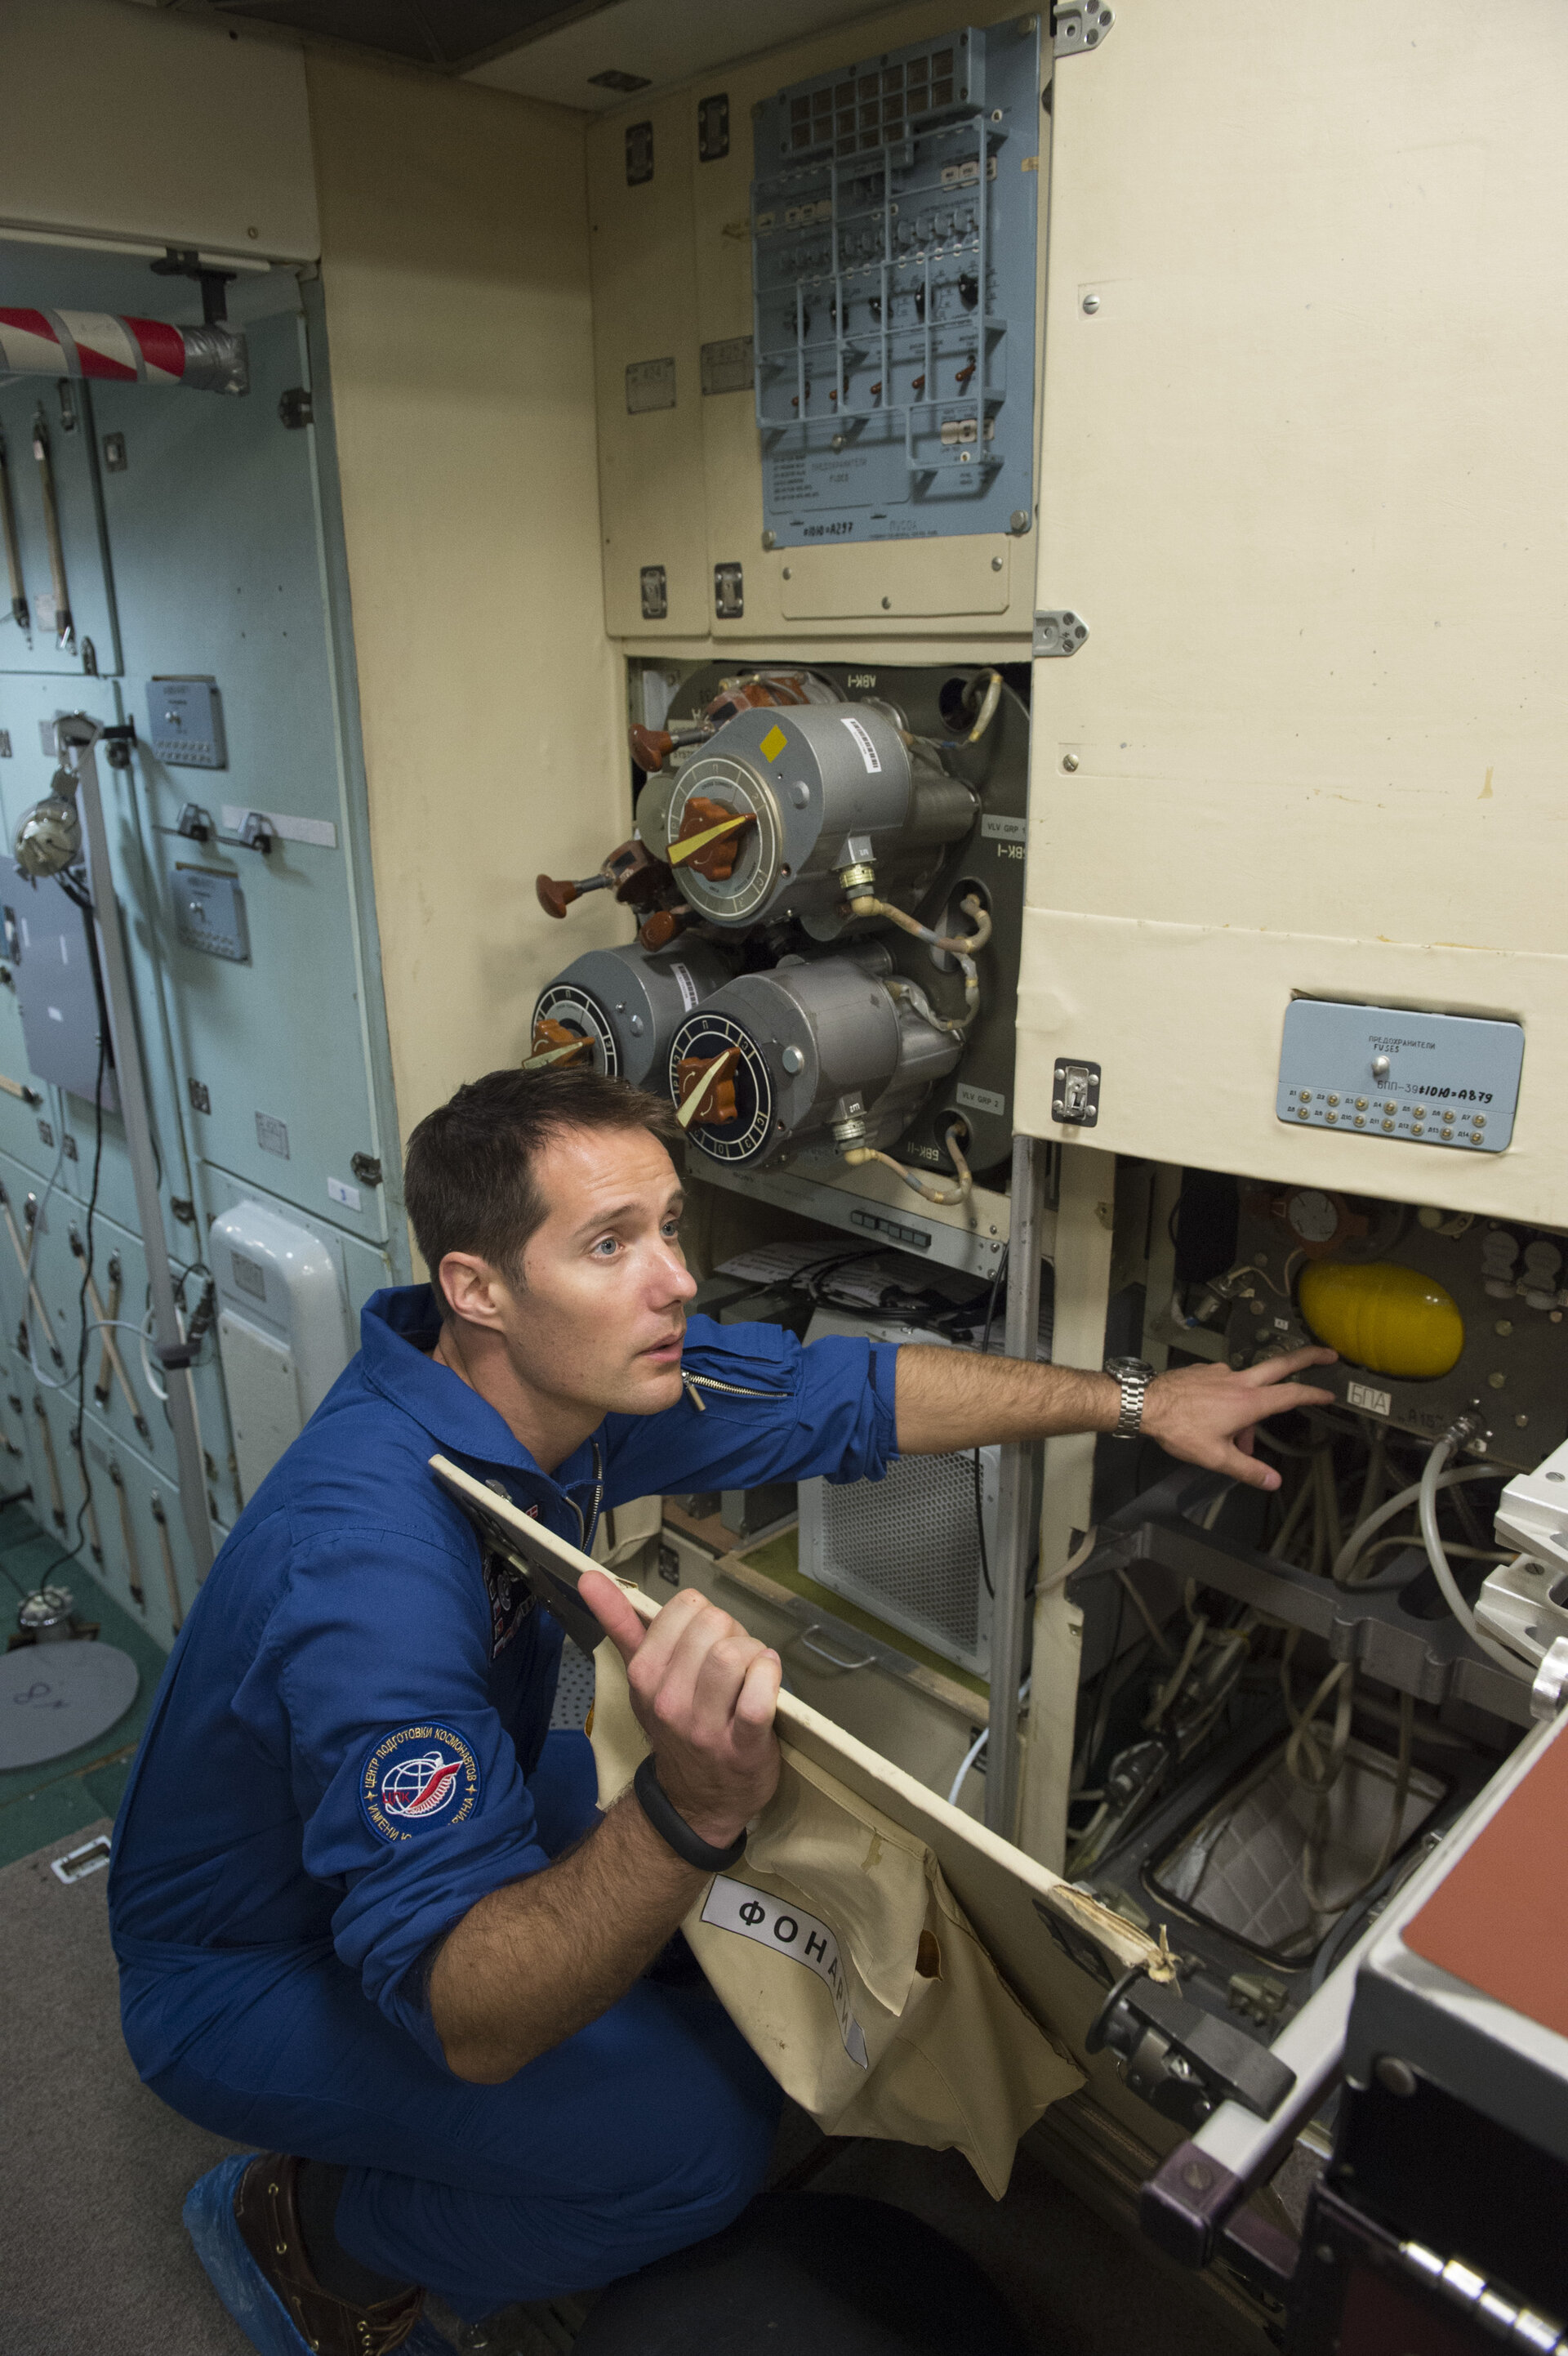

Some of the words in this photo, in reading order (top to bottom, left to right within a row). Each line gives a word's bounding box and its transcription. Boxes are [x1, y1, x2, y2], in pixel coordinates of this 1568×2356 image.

[987, 822, 1000, 832] VLV
[1004, 825, 1018, 833] GRP
[1369, 1036, 1436, 1050] ПРЕДОХРАНИТЕЛИ
[1374, 1043, 1400, 1053] FUSES
[1377, 1080, 1418, 1094] БПП-39
[962, 1091, 975, 1100] VLV
[978, 1095, 992, 1105] GRP
[1352, 1384, 1387, 1412] БПА
[364, 1757, 380, 1789] ЦЕНТР
[376, 1726, 433, 1760] ПОДГОТОВКИ
[435, 1728, 477, 1782] КОСМОНАВТОВ
[382, 1792, 411, 1806] ЦПК
[368, 1803, 399, 1841] ИМЕНИ
[738, 1900, 849, 2035] ФОНАРИ
